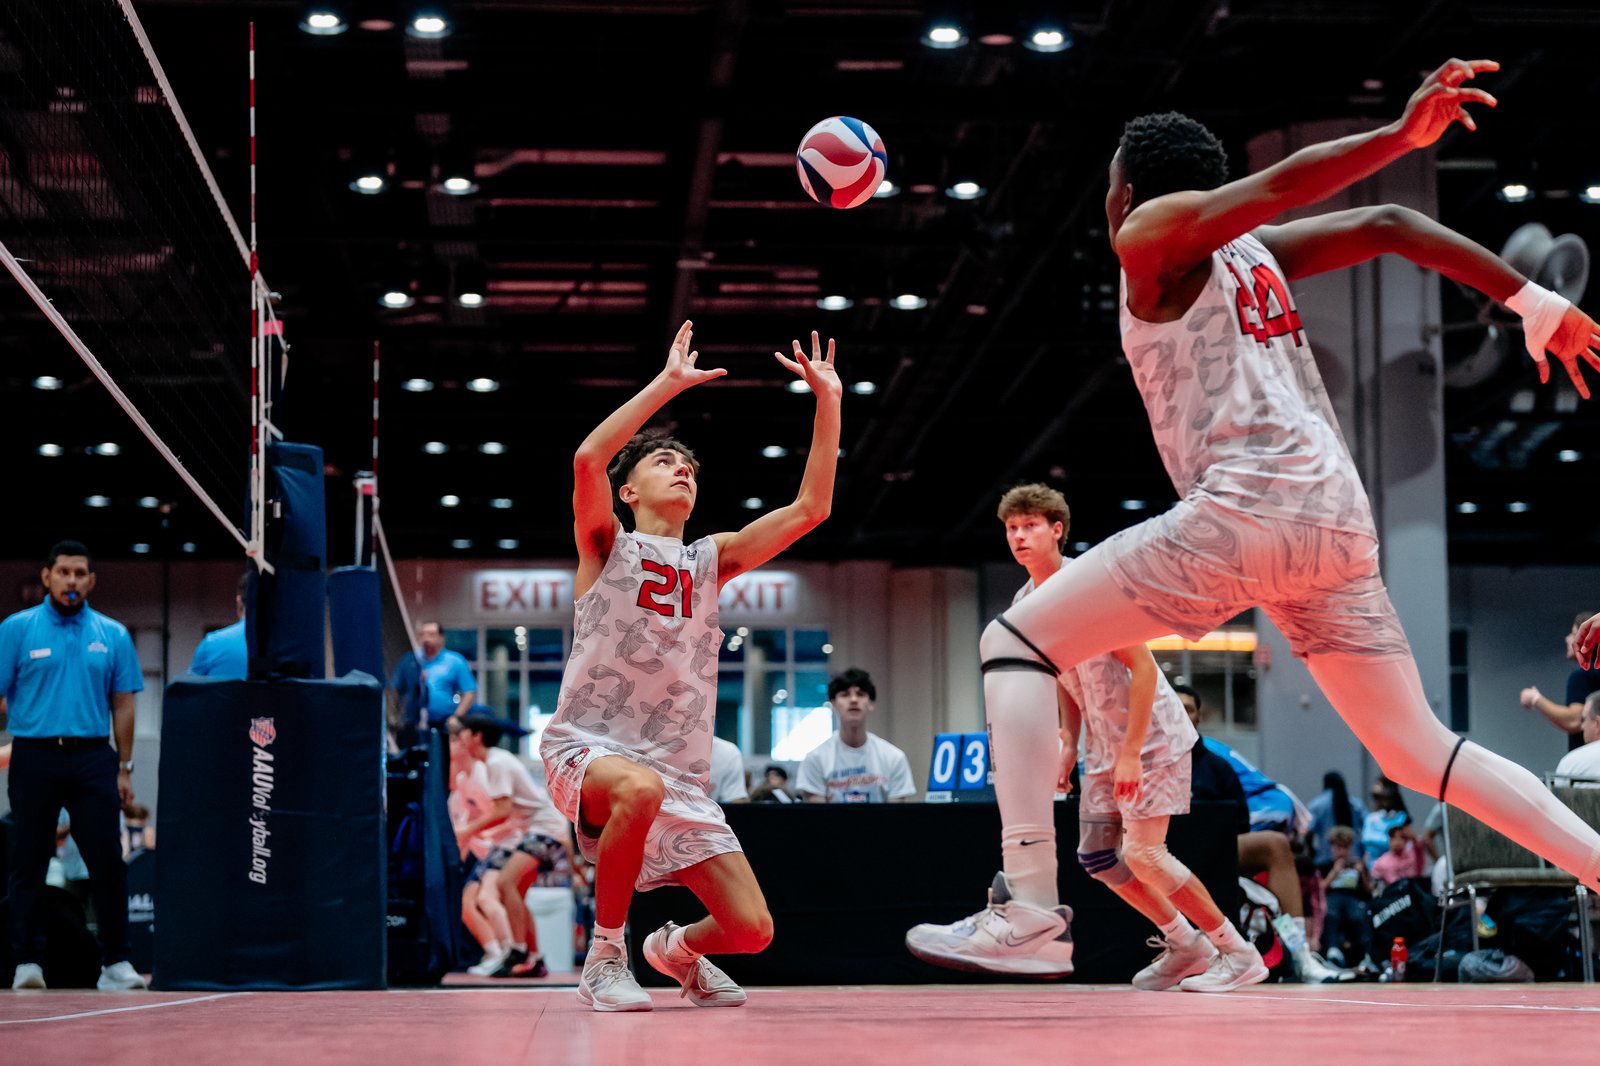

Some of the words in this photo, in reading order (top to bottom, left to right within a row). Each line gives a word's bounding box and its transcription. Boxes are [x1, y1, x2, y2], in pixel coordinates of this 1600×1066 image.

[481, 580, 567, 609] EXIT
[636, 558, 693, 618] 21
[719, 581, 792, 609] XIT
[933, 740, 985, 784] 03
[249, 746, 274, 884] AAUVolyball.org
